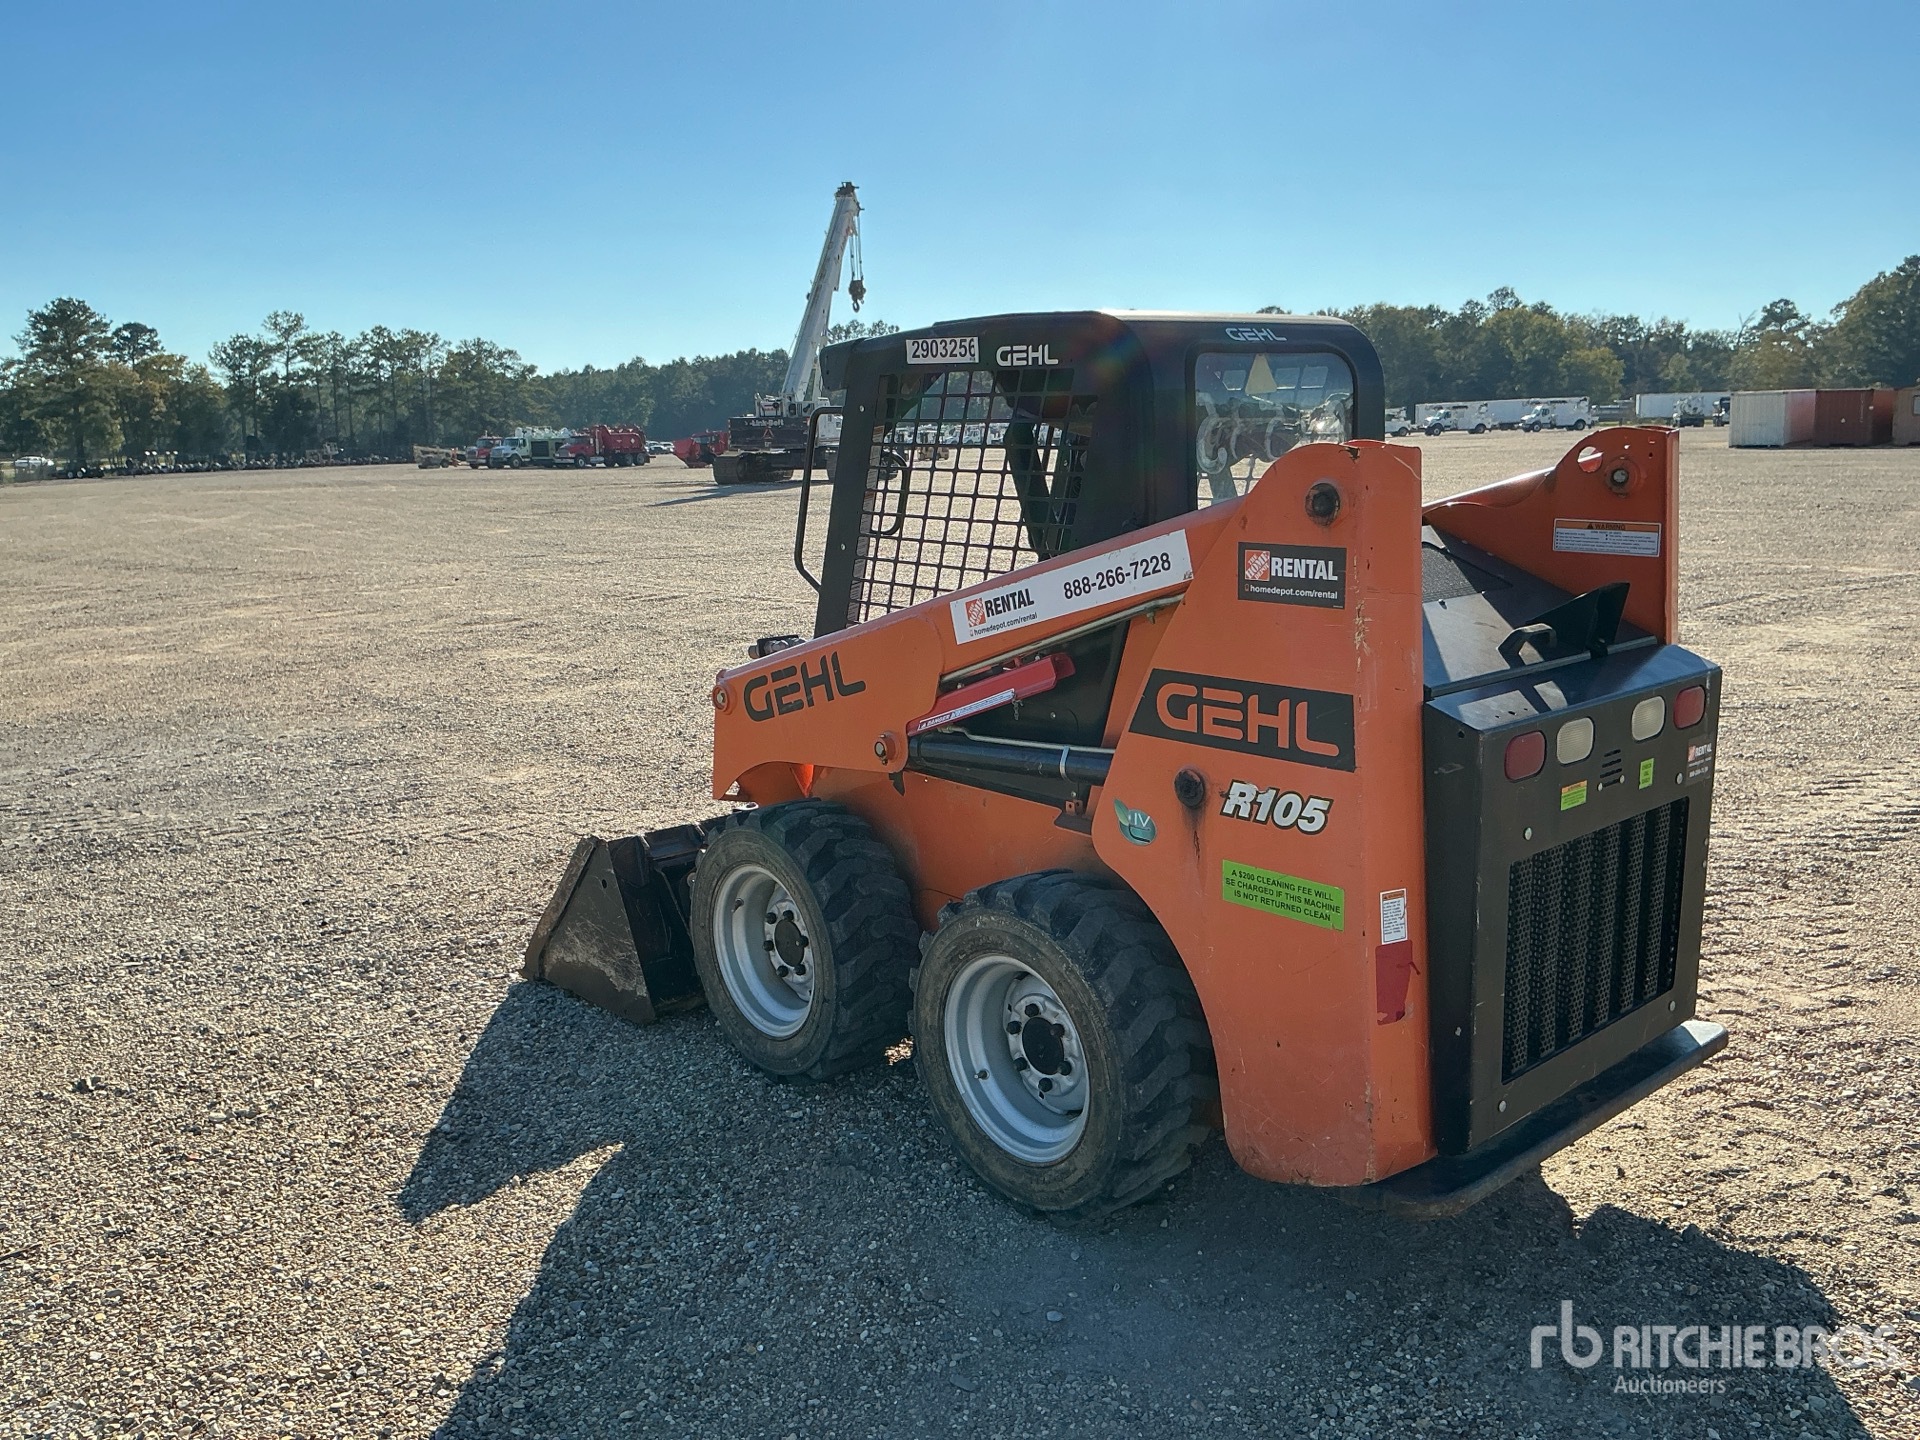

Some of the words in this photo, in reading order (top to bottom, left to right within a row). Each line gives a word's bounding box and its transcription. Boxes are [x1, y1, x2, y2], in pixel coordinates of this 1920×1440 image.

[911, 338, 976, 359] 2903256
[1225, 328, 1287, 341] GEHL
[996, 344, 1059, 367] GEHL
[1245, 551, 1270, 579] HOME
[1271, 557, 1338, 581] RENTAL
[985, 588, 1034, 618] RENTAL
[1063, 552, 1171, 600] 888-266-7228
[1250, 584, 1338, 600] homedepot.com/rental
[973, 612, 1037, 635] homedepot.com/rental
[744, 651, 866, 722] GEHL
[1156, 682, 1340, 757] GEHL
[1221, 780, 1332, 834] R105
[1225, 877, 1236, 887] BE
[1237, 881, 1274, 896] CHARGED
[1275, 890, 1283, 898] IF
[1285, 892, 1302, 904] THIS
[1304, 897, 1341, 914] MACHINE
[1231, 869, 1238, 877] A
[1238, 870, 1255, 881] $200
[1256, 875, 1296, 892] CLEANING
[1297, 885, 1313, 896] FEE
[1314, 890, 1334, 902] WILL
[1234, 889, 1242, 898] IS
[1243, 892, 1259, 903] NOT
[1260, 896, 1302, 914] RETURNED
[1303, 908, 1331, 922] CLEAN
